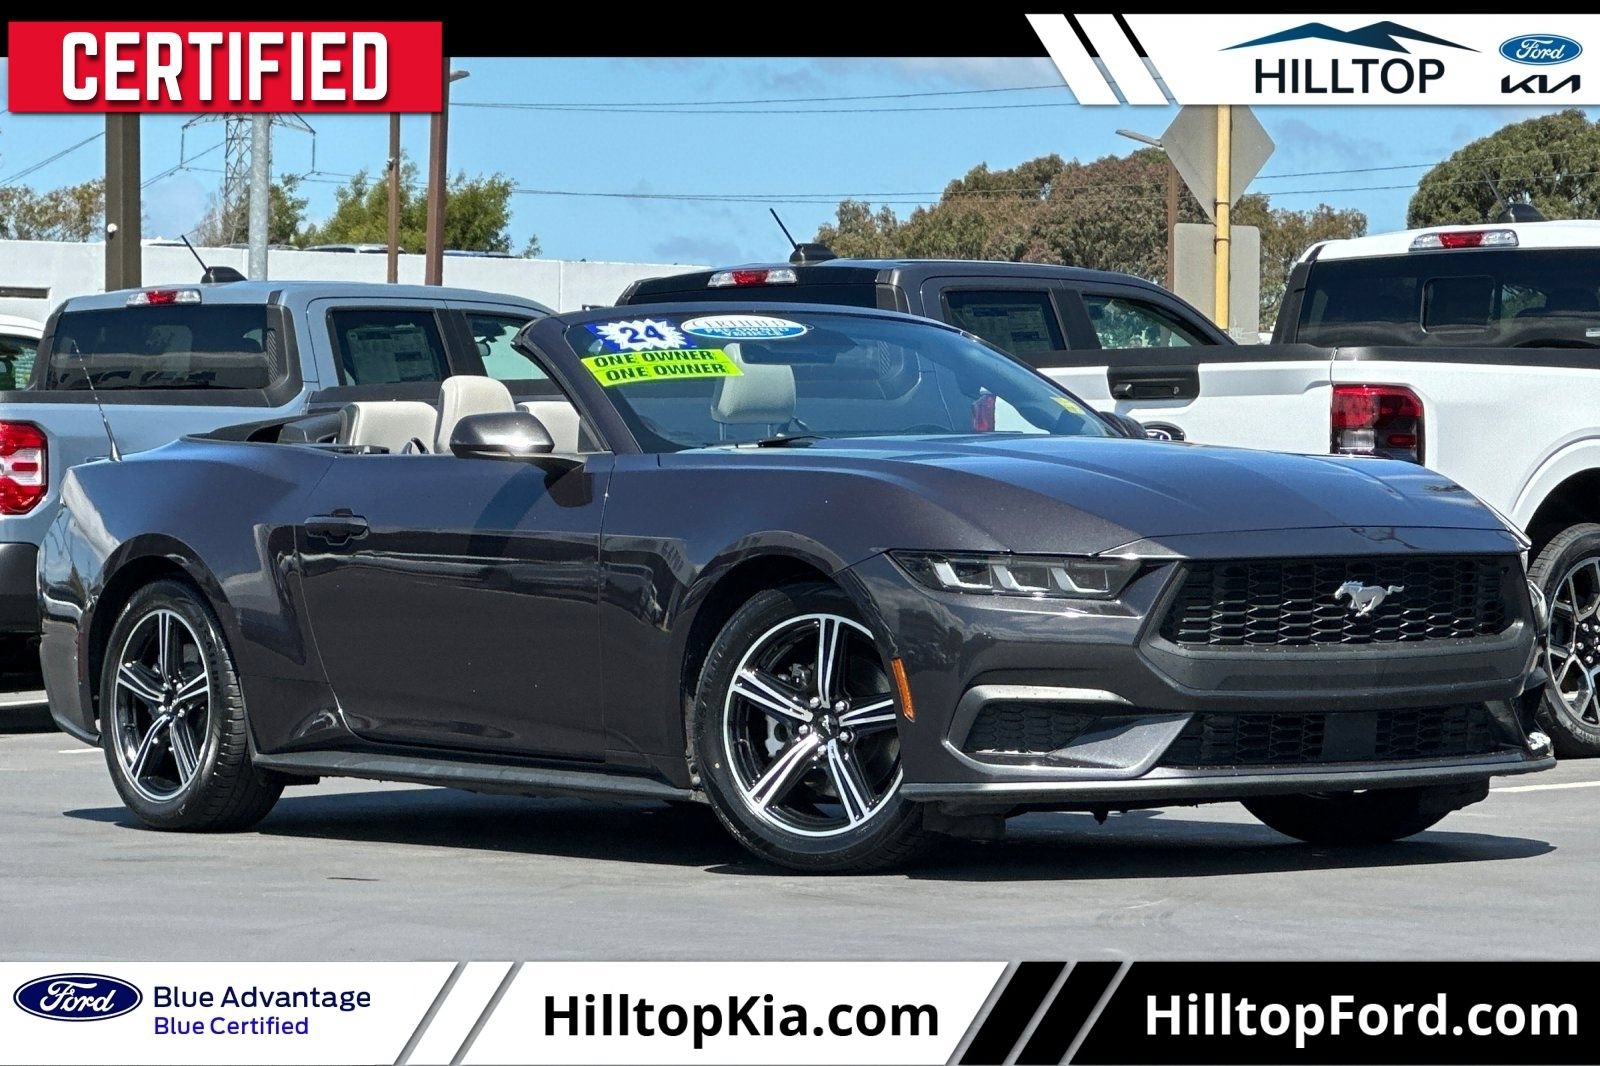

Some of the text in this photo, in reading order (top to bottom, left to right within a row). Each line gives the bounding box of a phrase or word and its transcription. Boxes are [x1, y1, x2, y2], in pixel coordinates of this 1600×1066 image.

[619, 325, 668, 344] 24
[594, 350, 714, 368] ONE OWNER
[606, 363, 726, 381] ONE OWNER
